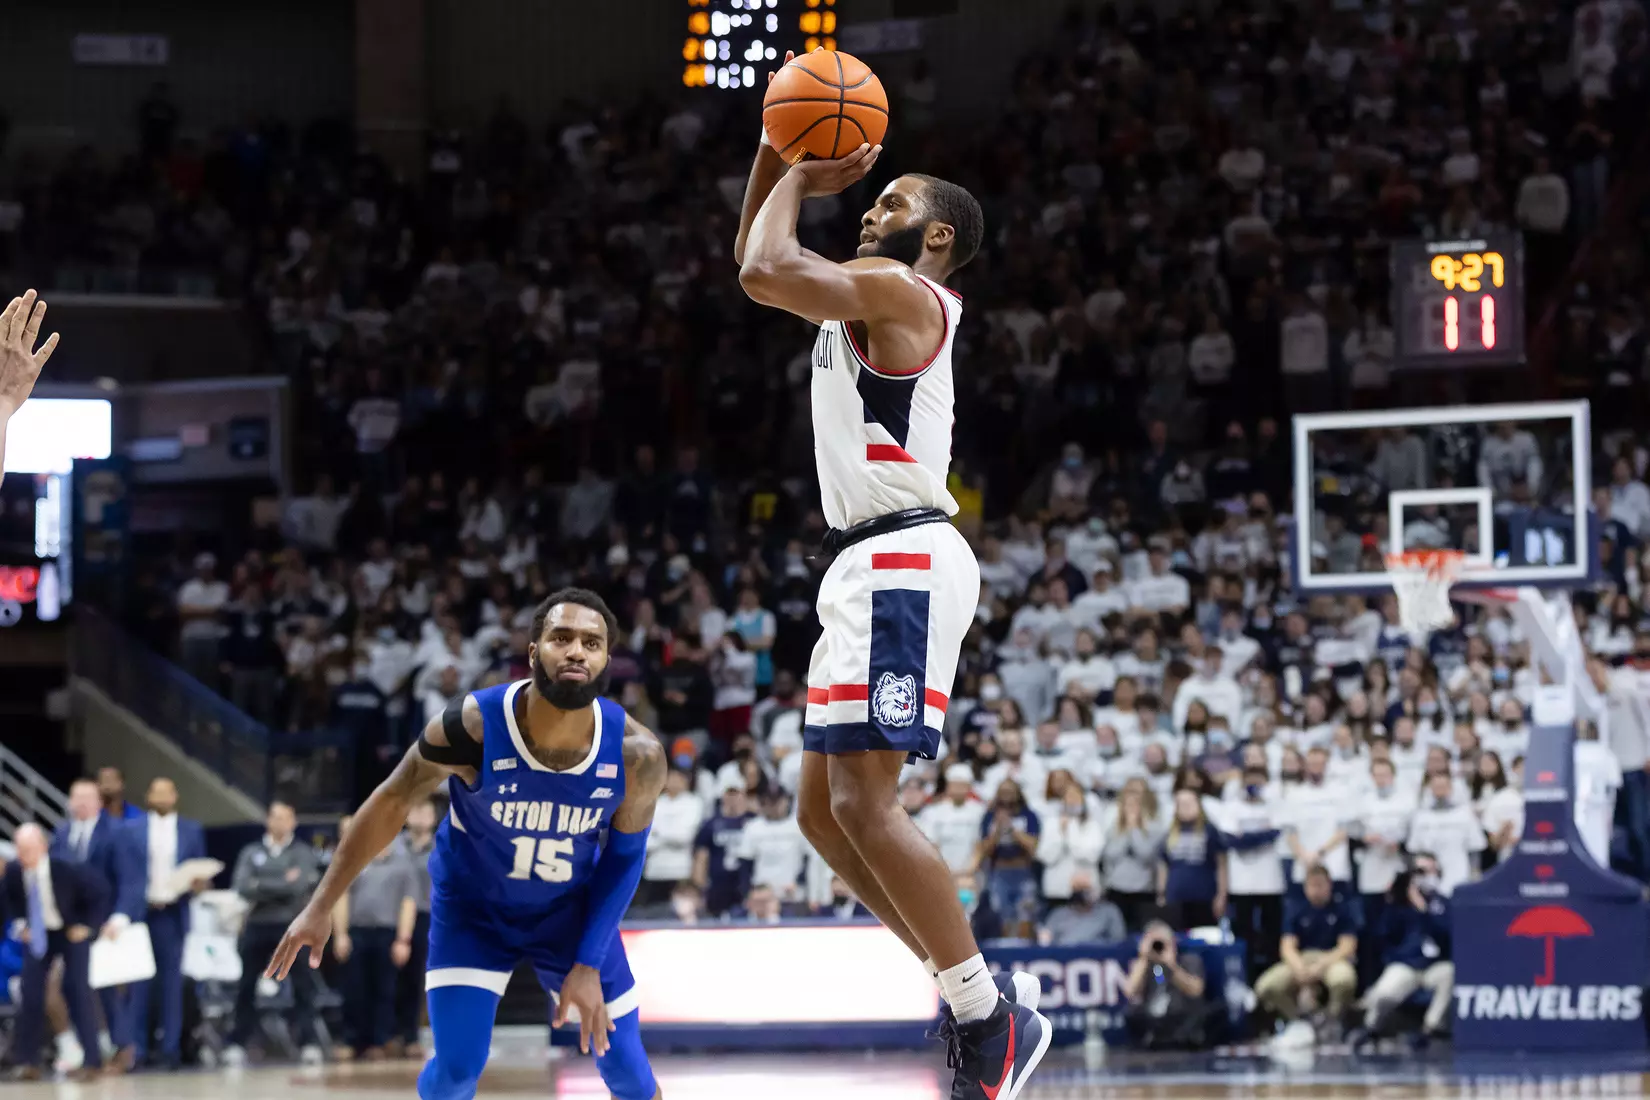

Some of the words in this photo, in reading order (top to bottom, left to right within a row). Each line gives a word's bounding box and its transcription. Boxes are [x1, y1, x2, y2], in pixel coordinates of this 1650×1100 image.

[1431, 252, 1504, 292] 9:27
[1444, 295, 1496, 351] 11
[490, 801, 553, 832] SETON
[506, 835, 574, 883] 15
[988, 958, 1137, 1008] CON
[1454, 985, 1643, 1020] TRAVELERS
